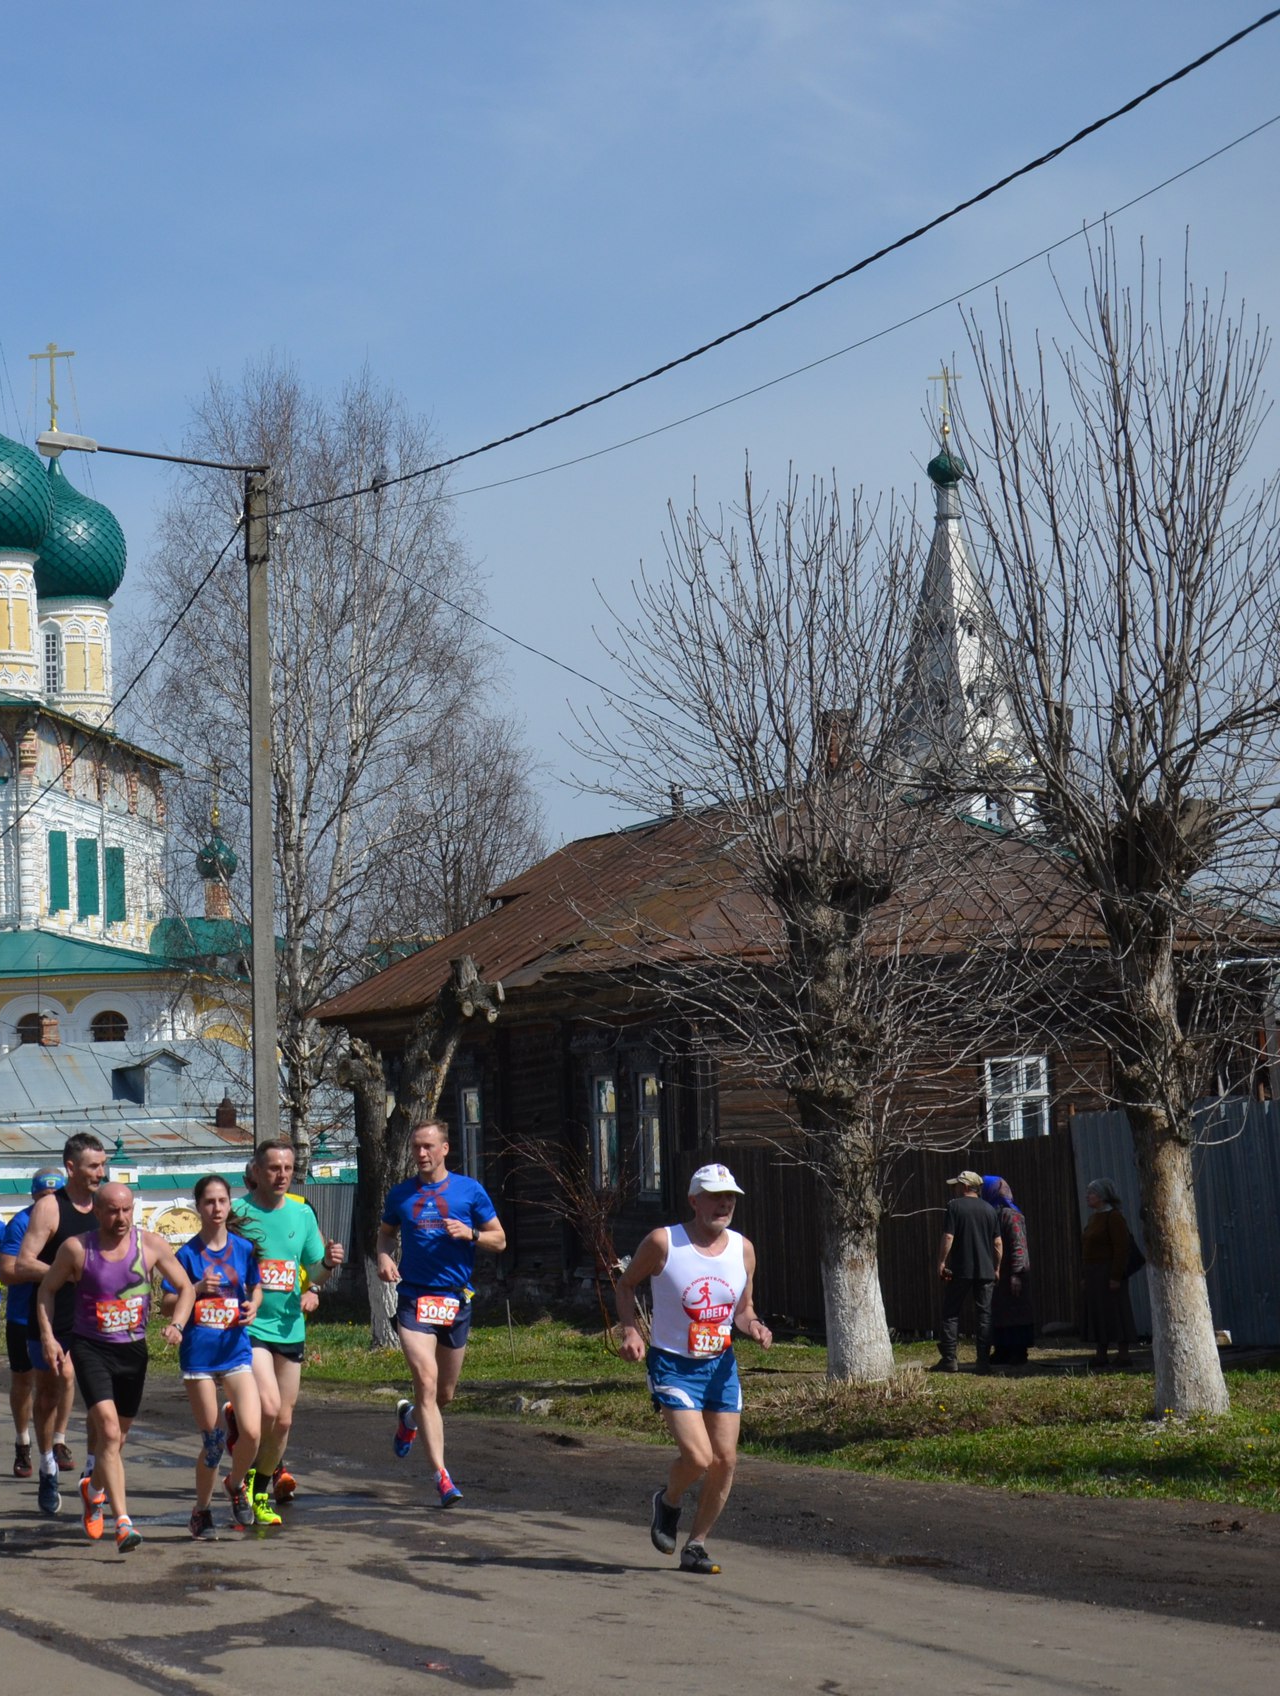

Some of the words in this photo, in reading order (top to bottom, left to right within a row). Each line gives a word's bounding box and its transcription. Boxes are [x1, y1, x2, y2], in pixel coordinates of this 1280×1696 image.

[262, 1269, 294, 1285] 3246
[102, 1308, 138, 1327] 3385
[200, 1308, 235, 1324] 3199
[420, 1304, 455, 1321] 3086
[699, 1305, 729, 1320] АВЕГА
